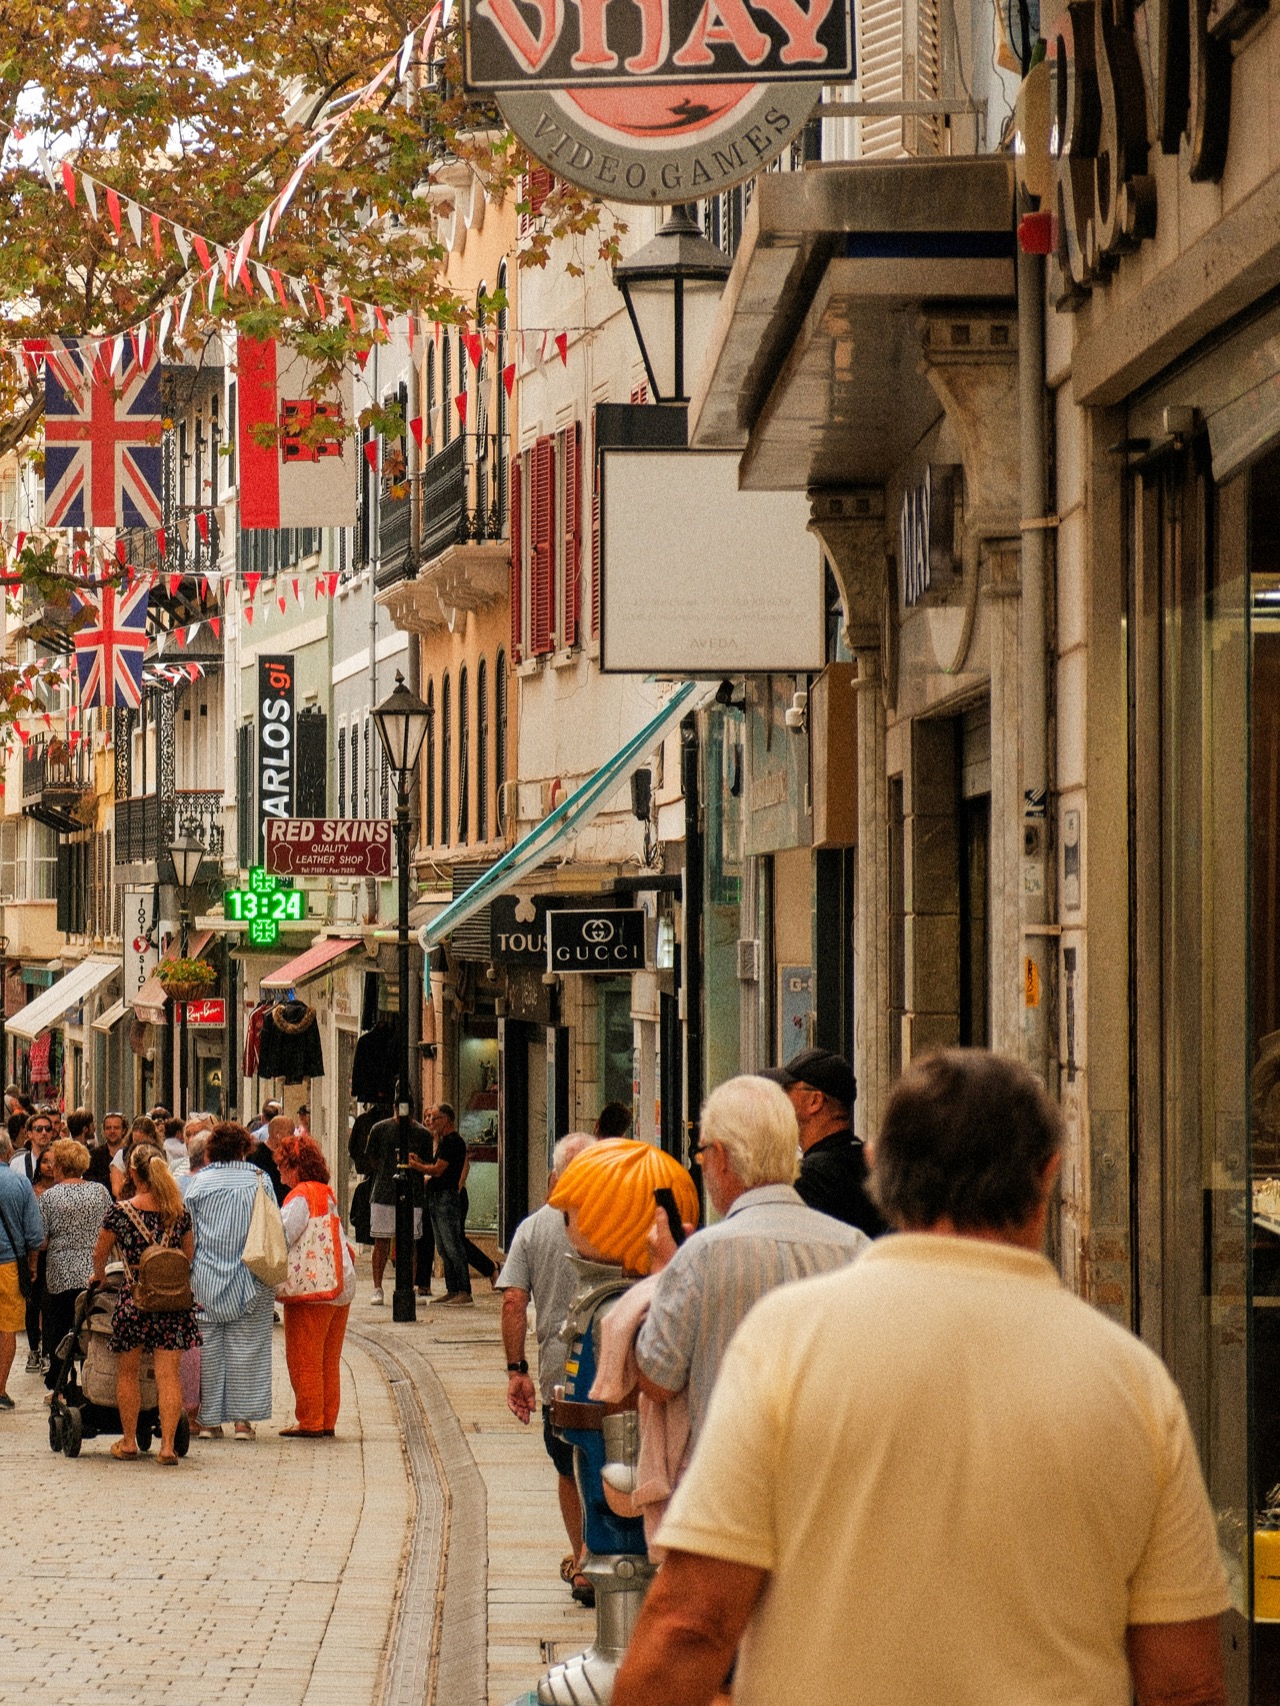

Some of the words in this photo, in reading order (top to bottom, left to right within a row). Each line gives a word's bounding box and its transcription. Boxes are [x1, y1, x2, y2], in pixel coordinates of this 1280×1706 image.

[476, 0, 827, 74] VIJAY
[531, 112, 647, 190] VIDEO
[660, 106, 791, 190] GAMES
[262, 663, 291, 837] ARLOS.gi
[271, 821, 315, 842] RED
[321, 821, 389, 843] SKINS
[296, 855, 335, 864] LEATHER
[339, 855, 363, 865] SHOP
[311, 844, 349, 853] QUALITY
[138, 898, 146, 934] foot
[230, 892, 300, 919] 13:24
[556, 944, 637, 961] GUCCI
[186, 1001, 220, 1022] Ray-Ban
